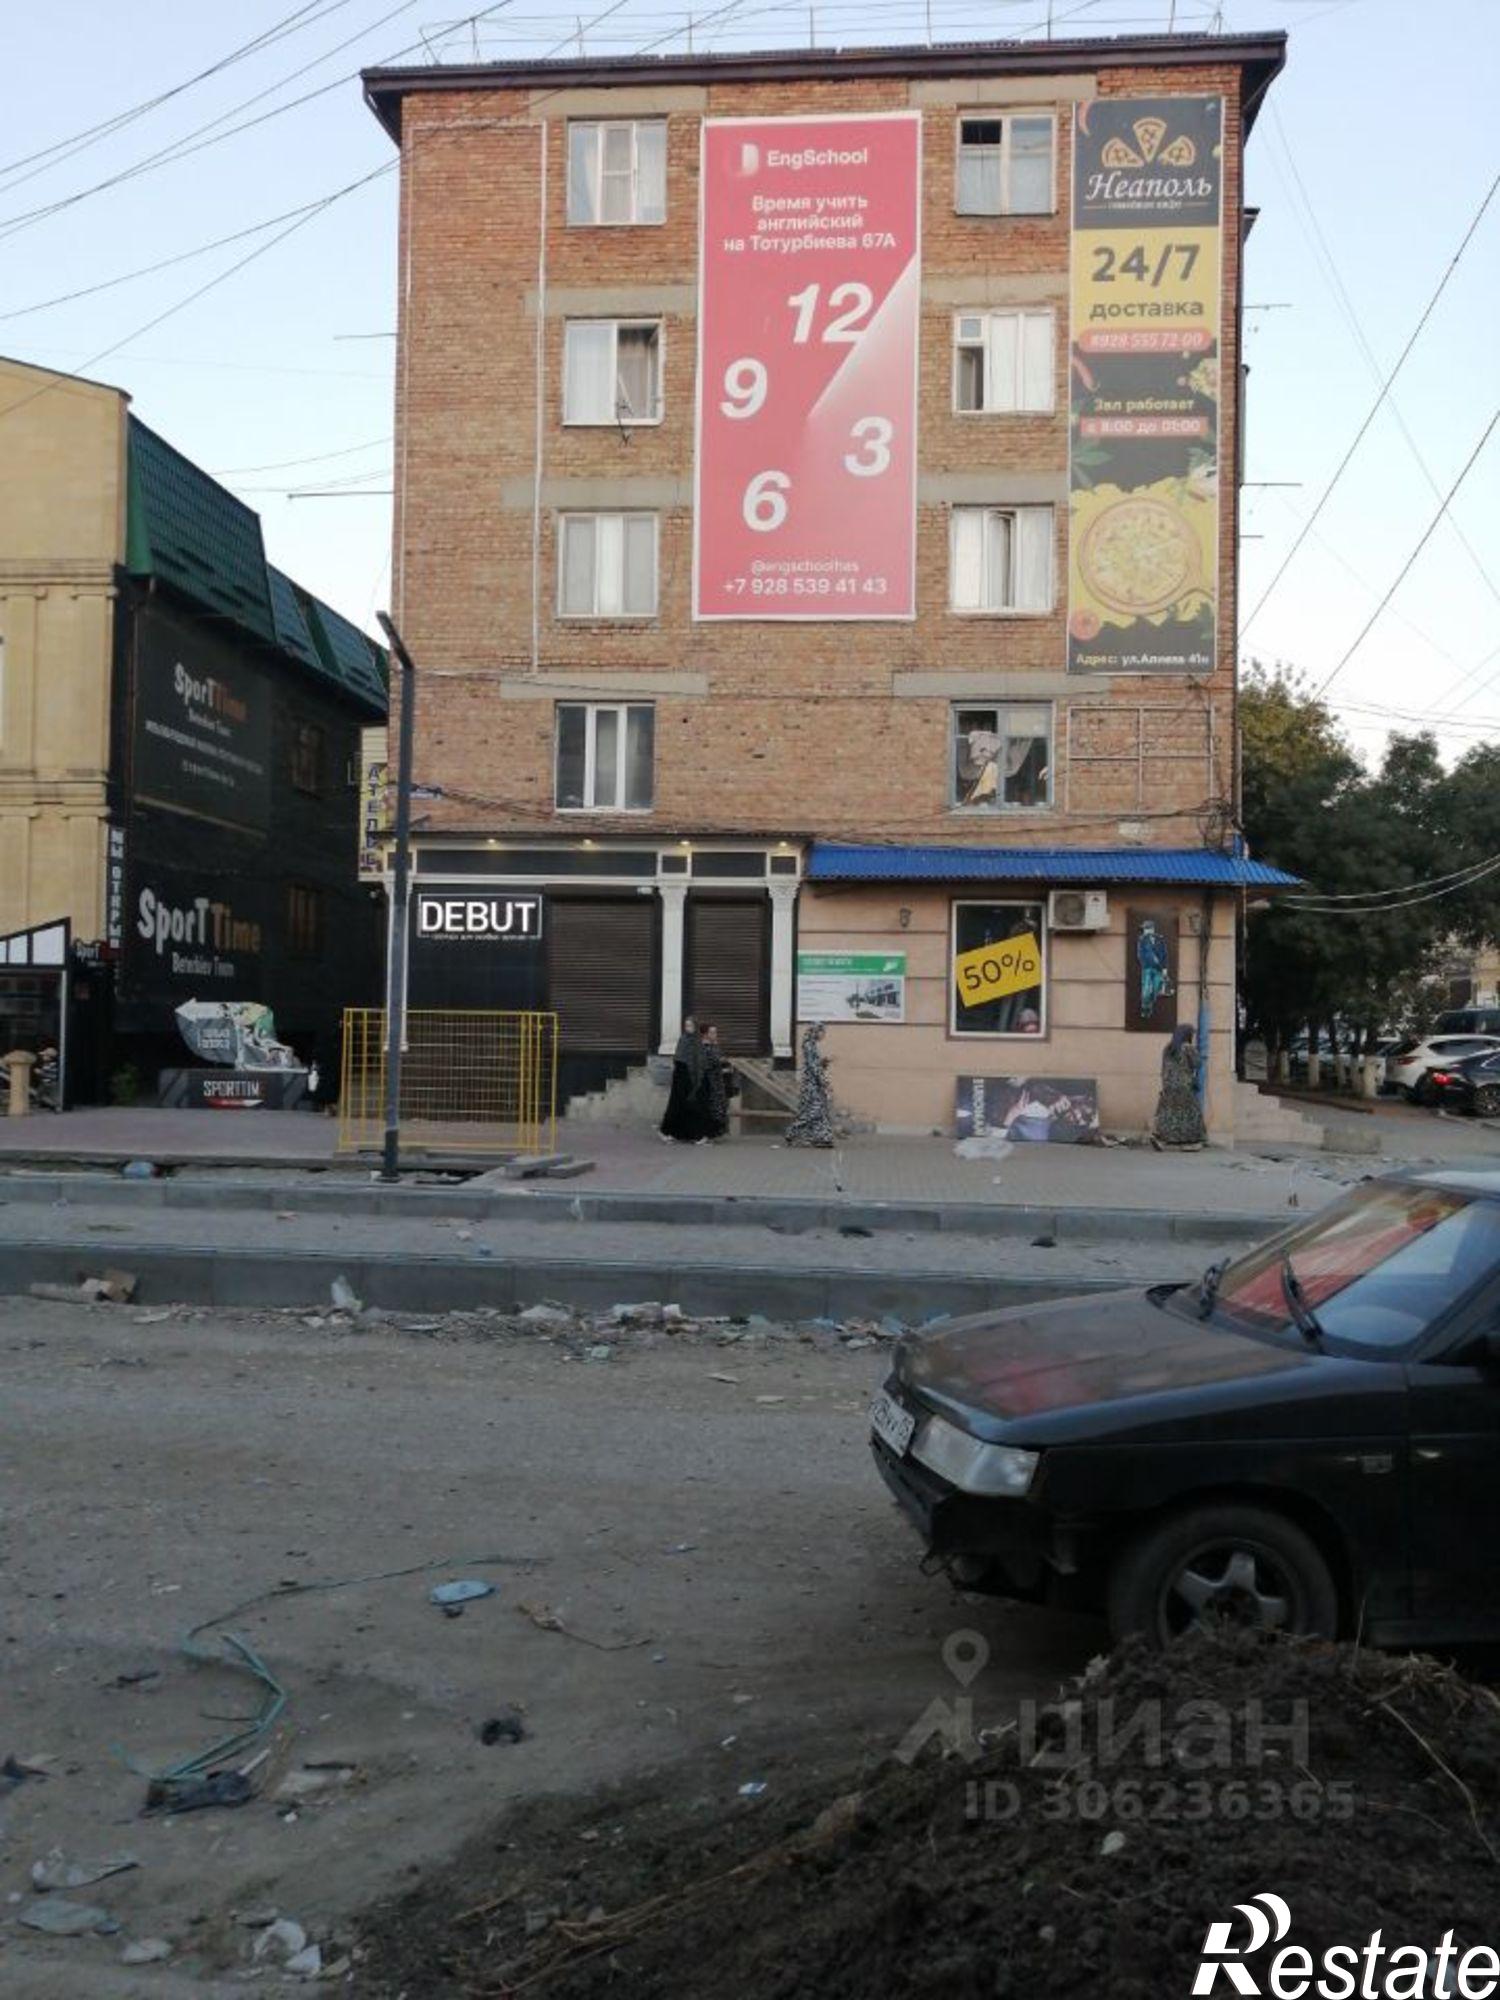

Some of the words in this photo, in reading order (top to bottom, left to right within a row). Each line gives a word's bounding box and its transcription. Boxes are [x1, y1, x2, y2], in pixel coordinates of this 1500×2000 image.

[767, 148, 868, 169] EngSchool
[1085, 170, 1212, 200] Неаполь
[752, 196, 810, 213] Время
[816, 195, 868, 213] учить
[757, 215, 864, 231] английский
[724, 238, 744, 251] на
[750, 233, 857, 253] Тотурбиева
[1092, 243, 1200, 287] 24/7
[787, 282, 874, 344] 12
[1089, 301, 1204, 320] доставка
[719, 357, 768, 419] 9
[1126, 396, 1195, 413] работает
[844, 415, 894, 477] 3
[743, 470, 792, 532] 6
[723, 579, 746, 595] +7
[751, 578, 788, 595] 928
[792, 578, 830, 595] 539
[835, 578, 856, 594] 41
[862, 577, 888, 594] 43
[421, 900, 536, 932] DEBUT
[963, 950, 1035, 991] 50%
